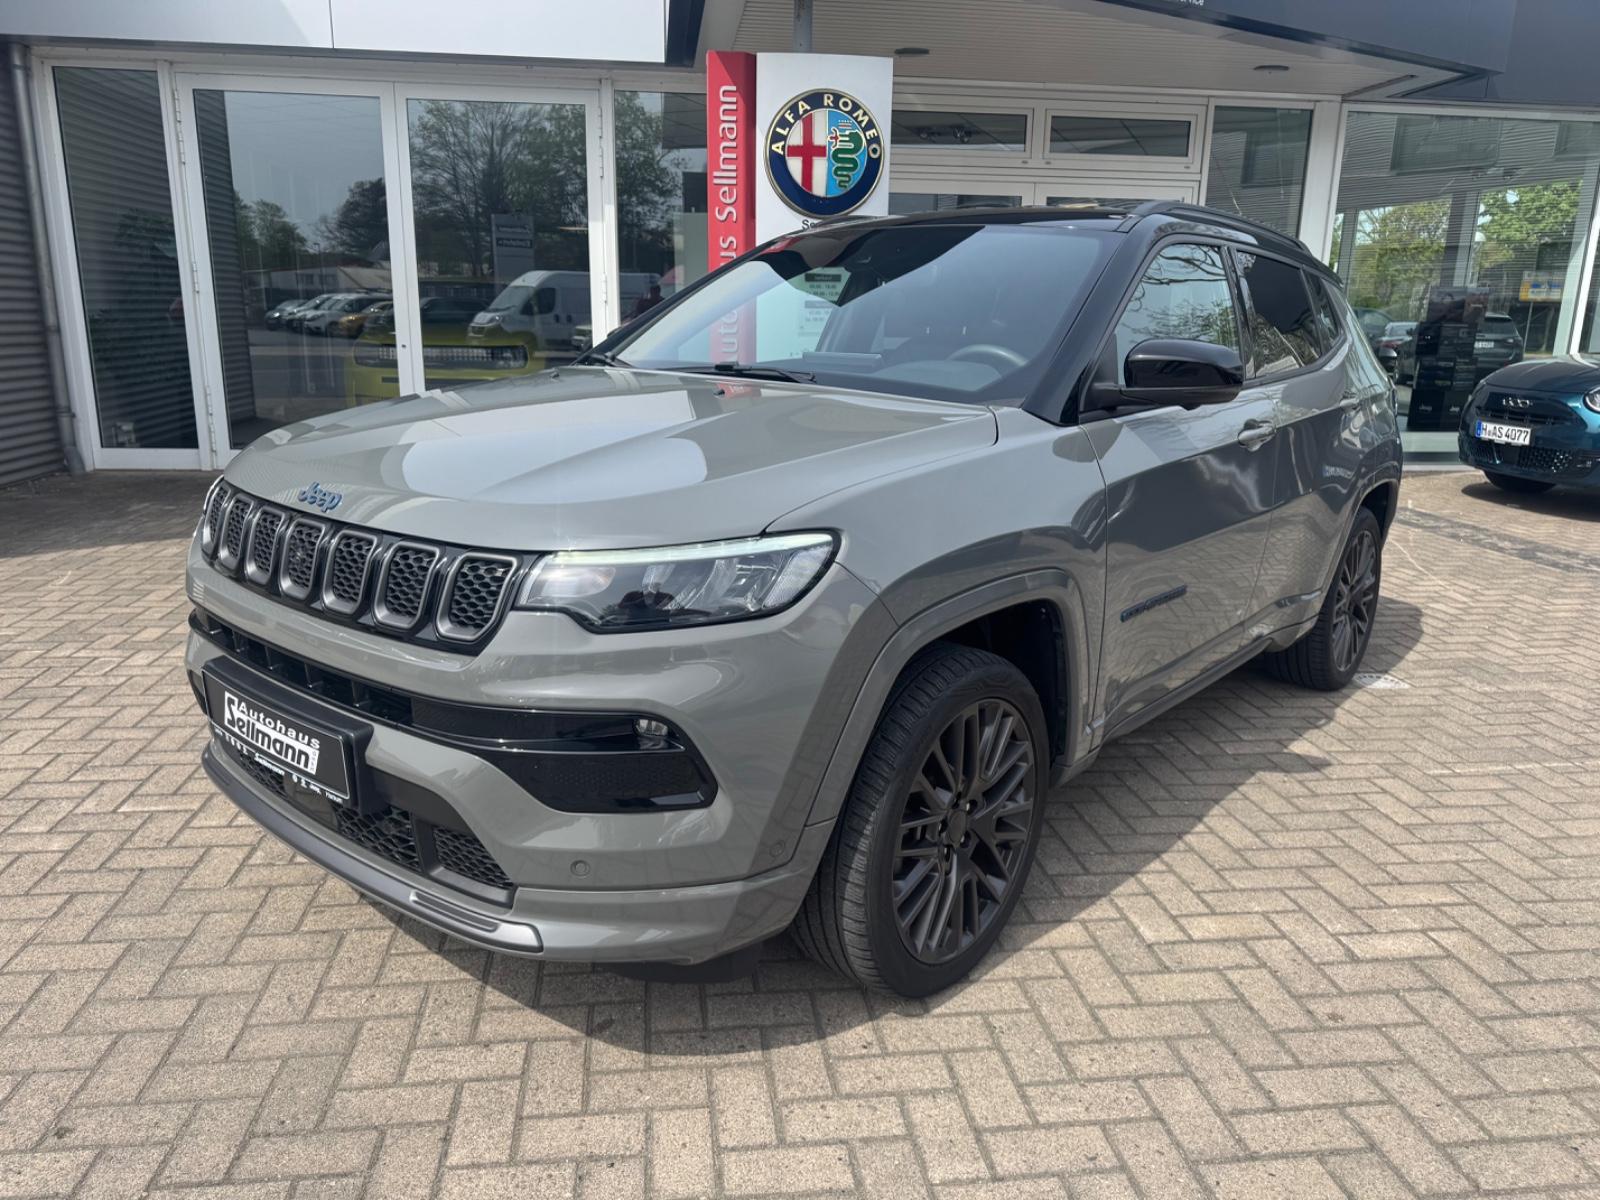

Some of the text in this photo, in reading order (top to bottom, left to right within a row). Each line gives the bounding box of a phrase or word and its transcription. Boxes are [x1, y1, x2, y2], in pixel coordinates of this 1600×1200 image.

[713, 85, 737, 223] Sellmann
[771, 93, 881, 159] ALFA ROMEO
[1505, 427, 1529, 442] 4077
[298, 482, 342, 513] Jeep
[226, 695, 310, 770] Sellmann
[238, 702, 320, 749] Autohaus
